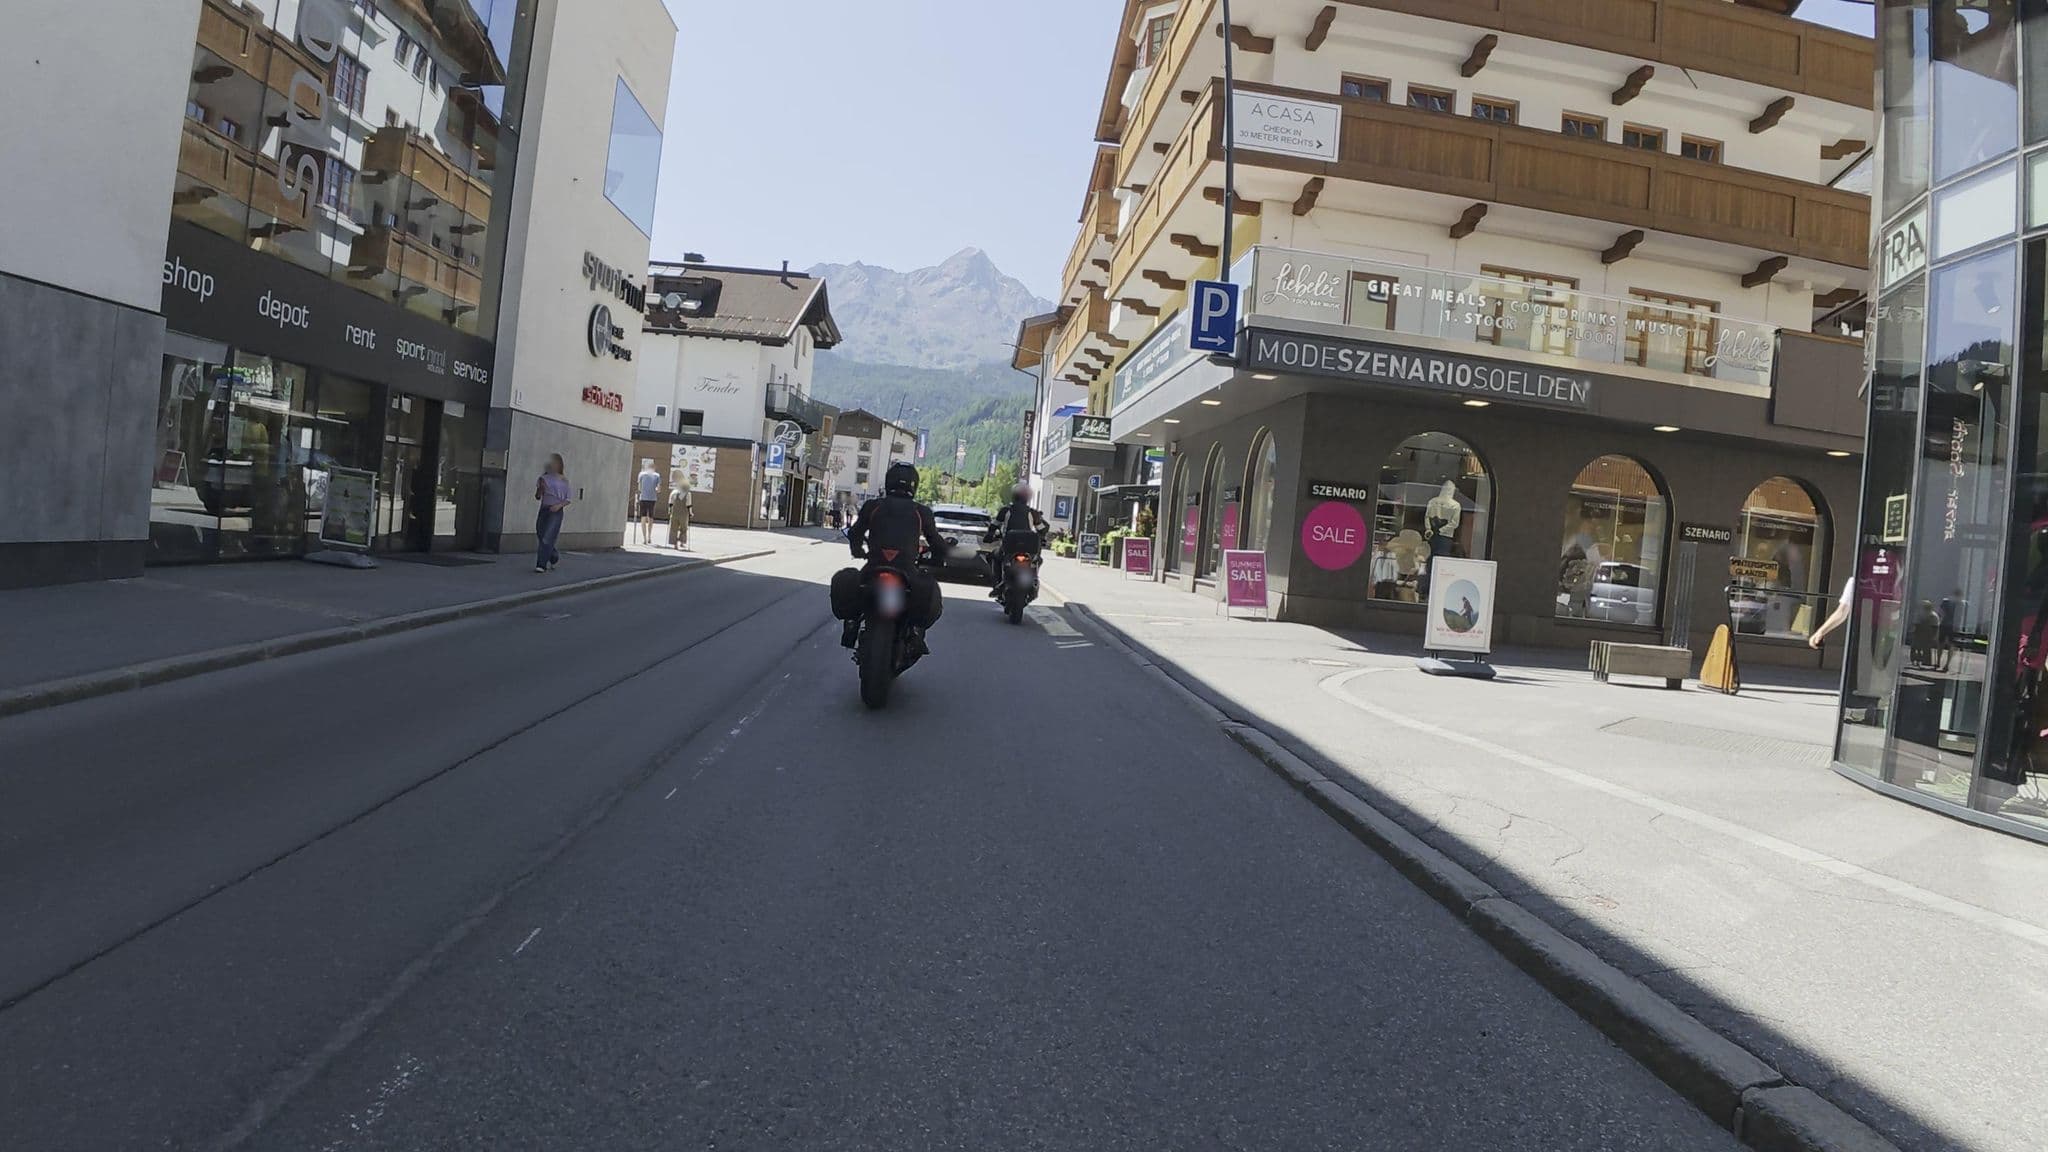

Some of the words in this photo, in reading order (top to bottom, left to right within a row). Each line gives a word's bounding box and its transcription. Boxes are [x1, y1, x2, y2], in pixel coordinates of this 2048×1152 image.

[1251, 103, 1263, 116] A
[1267, 104, 1315, 125] CASA
[1250, 132, 1279, 142] METER
[1281, 135, 1314, 148] RECHTS
[1263, 124, 1291, 135] CHECK
[162, 256, 215, 303] shop
[259, 290, 310, 328] depot
[1200, 287, 1230, 332] P
[1367, 280, 1422, 298] GREAT
[1431, 288, 1487, 308] MEALS
[1510, 300, 1551, 317] COOL
[1559, 308, 1617, 326] DRINKS
[1634, 319, 1684, 337] MUSIC
[345, 324, 376, 350] rent
[1464, 312, 1515, 330] STOCK
[1566, 327, 1613, 345] FLOOR
[453, 360, 488, 384] service
[1257, 338, 1587, 403] MODESZENARIOSOELDEN
[770, 445, 782, 462] P
[1312, 485, 1367, 500] SZENARIO
[1312, 526, 1355, 544] SALE
[1685, 526, 1731, 541] SZENARIO
[1230, 560, 1262, 569] SUMMER
[1231, 570, 1262, 582] SALE
